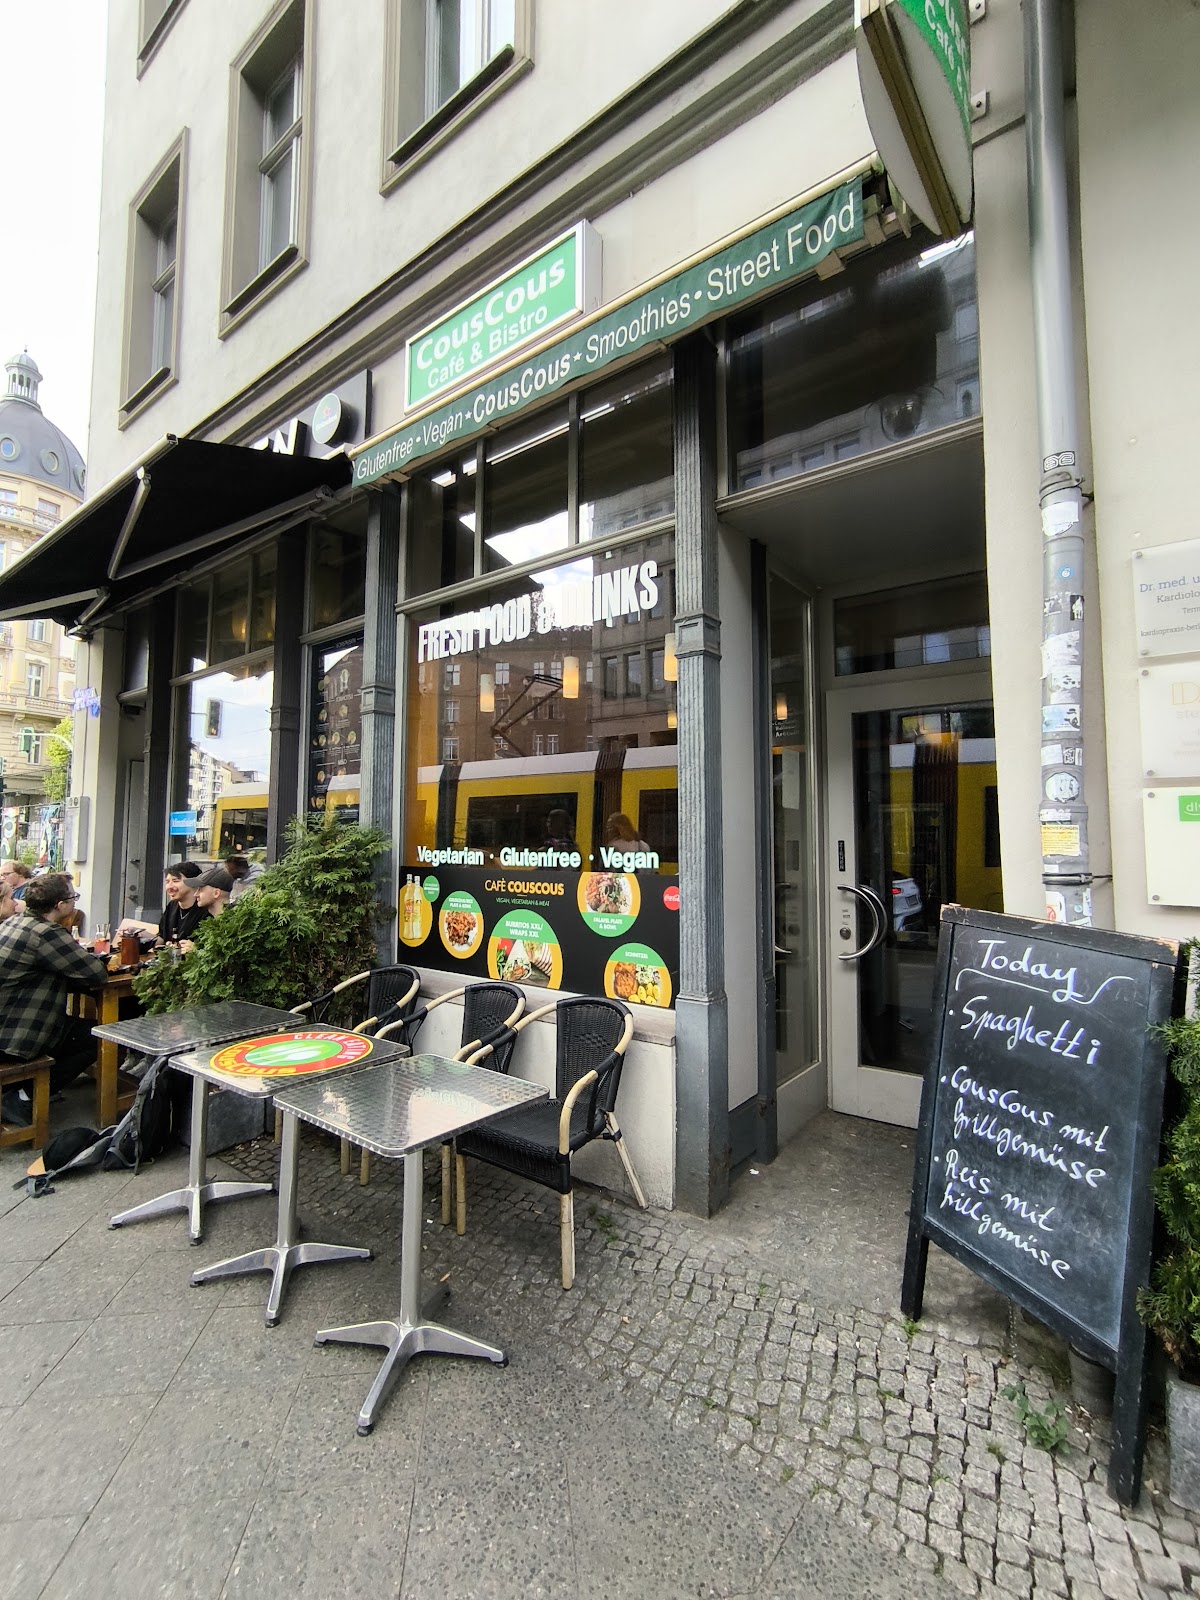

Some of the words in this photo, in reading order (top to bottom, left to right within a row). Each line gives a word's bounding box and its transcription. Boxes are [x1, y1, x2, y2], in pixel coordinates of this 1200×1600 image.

[356, 436, 413, 480] Glutenfree
[422, 411, 464, 445] Vegan
[473, 352, 571, 423] CousCous
[586, 292, 691, 363] Smoothies
[707, 237, 781, 301] Street
[787, 192, 855, 265] Food
[416, 258, 566, 370] CousCous
[427, 353, 465, 389] Café
[469, 341, 483, 364] &
[489, 306, 548, 353] Bistro
[1139, 583, 1156, 593] Dr.
[1158, 575, 1189, 590] med.
[479, 593, 531, 649] FOOD
[417, 845, 485, 867] Vegetarian
[500, 847, 581, 868] Glutenfree
[600, 847, 660, 873] Vegan
[507, 880, 565, 896] COUSCOUS
[505, 920, 530, 929] BURRITOS
[509, 928, 528, 937] WRAPS
[528, 930, 539, 938] XXL
[625, 951, 648, 959] SCHNITZEL
[978, 939, 1083, 1003] Today
[960, 995, 1101, 1065] Spaghetti
[951, 1065, 1055, 1126] CousCous
[1059, 1124, 1110, 1153] mit
[945, 1148, 991, 1195] Reis
[1000, 1193, 1056, 1232] mit
